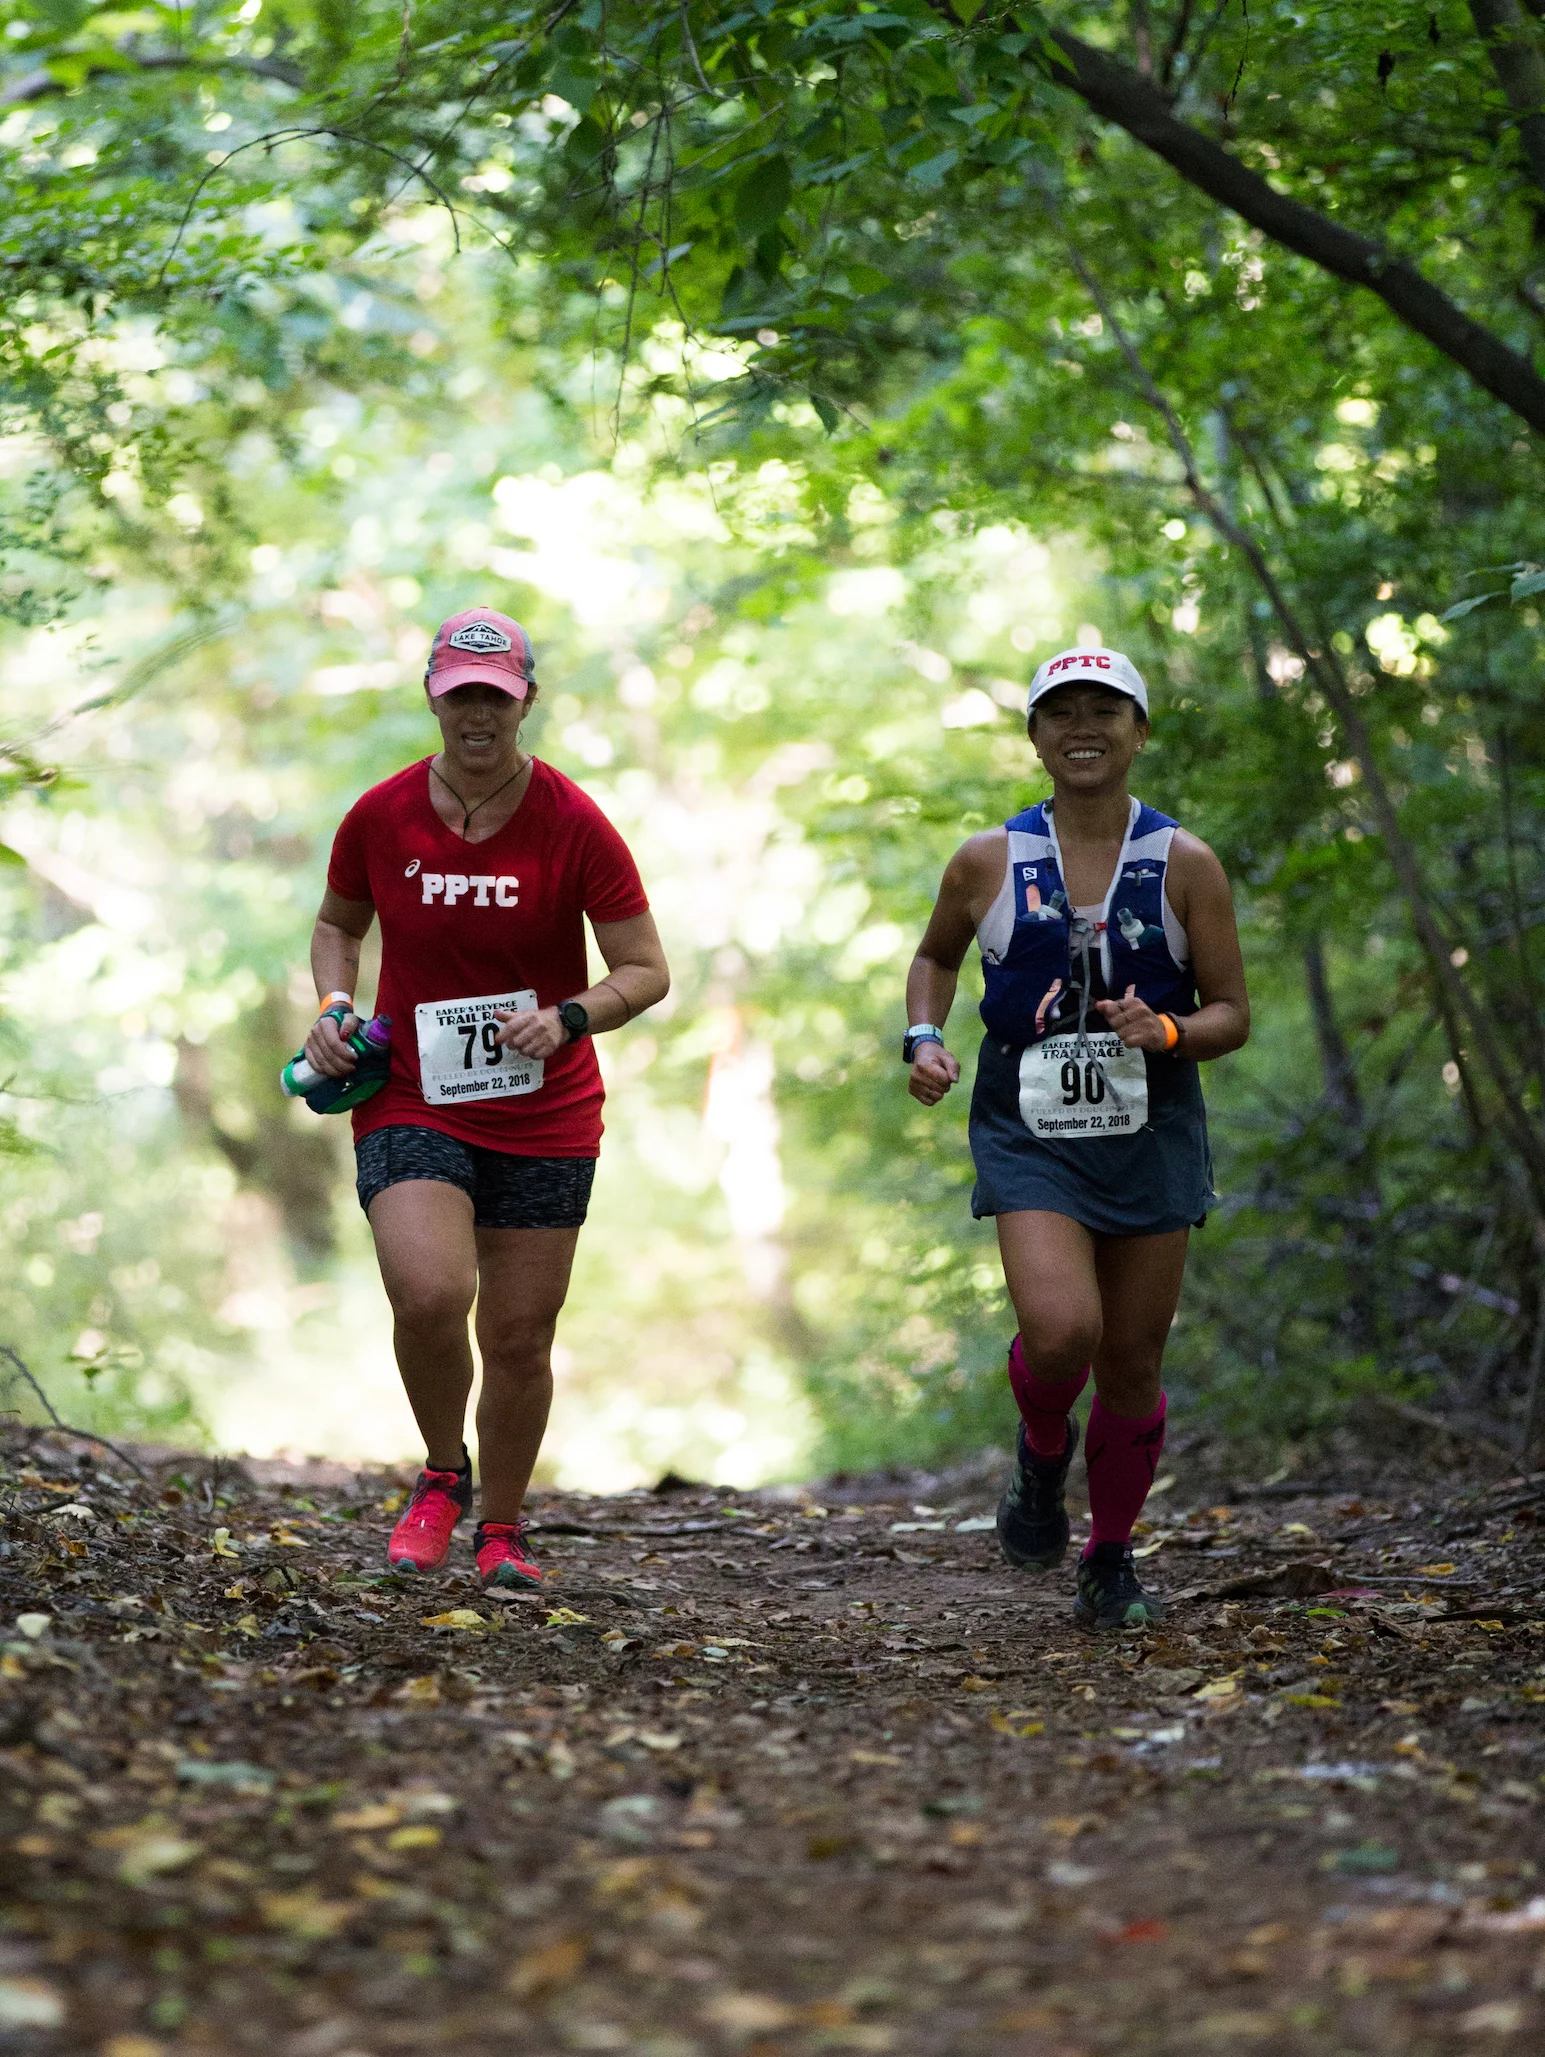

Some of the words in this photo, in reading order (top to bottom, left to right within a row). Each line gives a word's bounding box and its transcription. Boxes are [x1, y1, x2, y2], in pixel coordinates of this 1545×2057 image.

[454, 633, 475, 642] LAKE
[480, 633, 508, 646] TAHOE
[1047, 655, 1111, 677] PPTC
[421, 873, 520, 908] PPTC
[436, 1006, 473, 1016] BAKER'S
[475, 1000, 517, 1011] REVENGE
[437, 1014, 480, 1026] TRAIL
[458, 1022, 503, 1070] 79
[1081, 1039, 1123, 1047] REVENGE
[440, 1080, 489, 1098] September
[491, 1077, 507, 1091] 22,
[508, 1073, 531, 1088] 2018
[1061, 1060, 1105, 1106] 90
[1037, 1117, 1088, 1132] September
[1090, 1116, 1106, 1130] 22,
[1108, 1114, 1130, 1127] 2018
